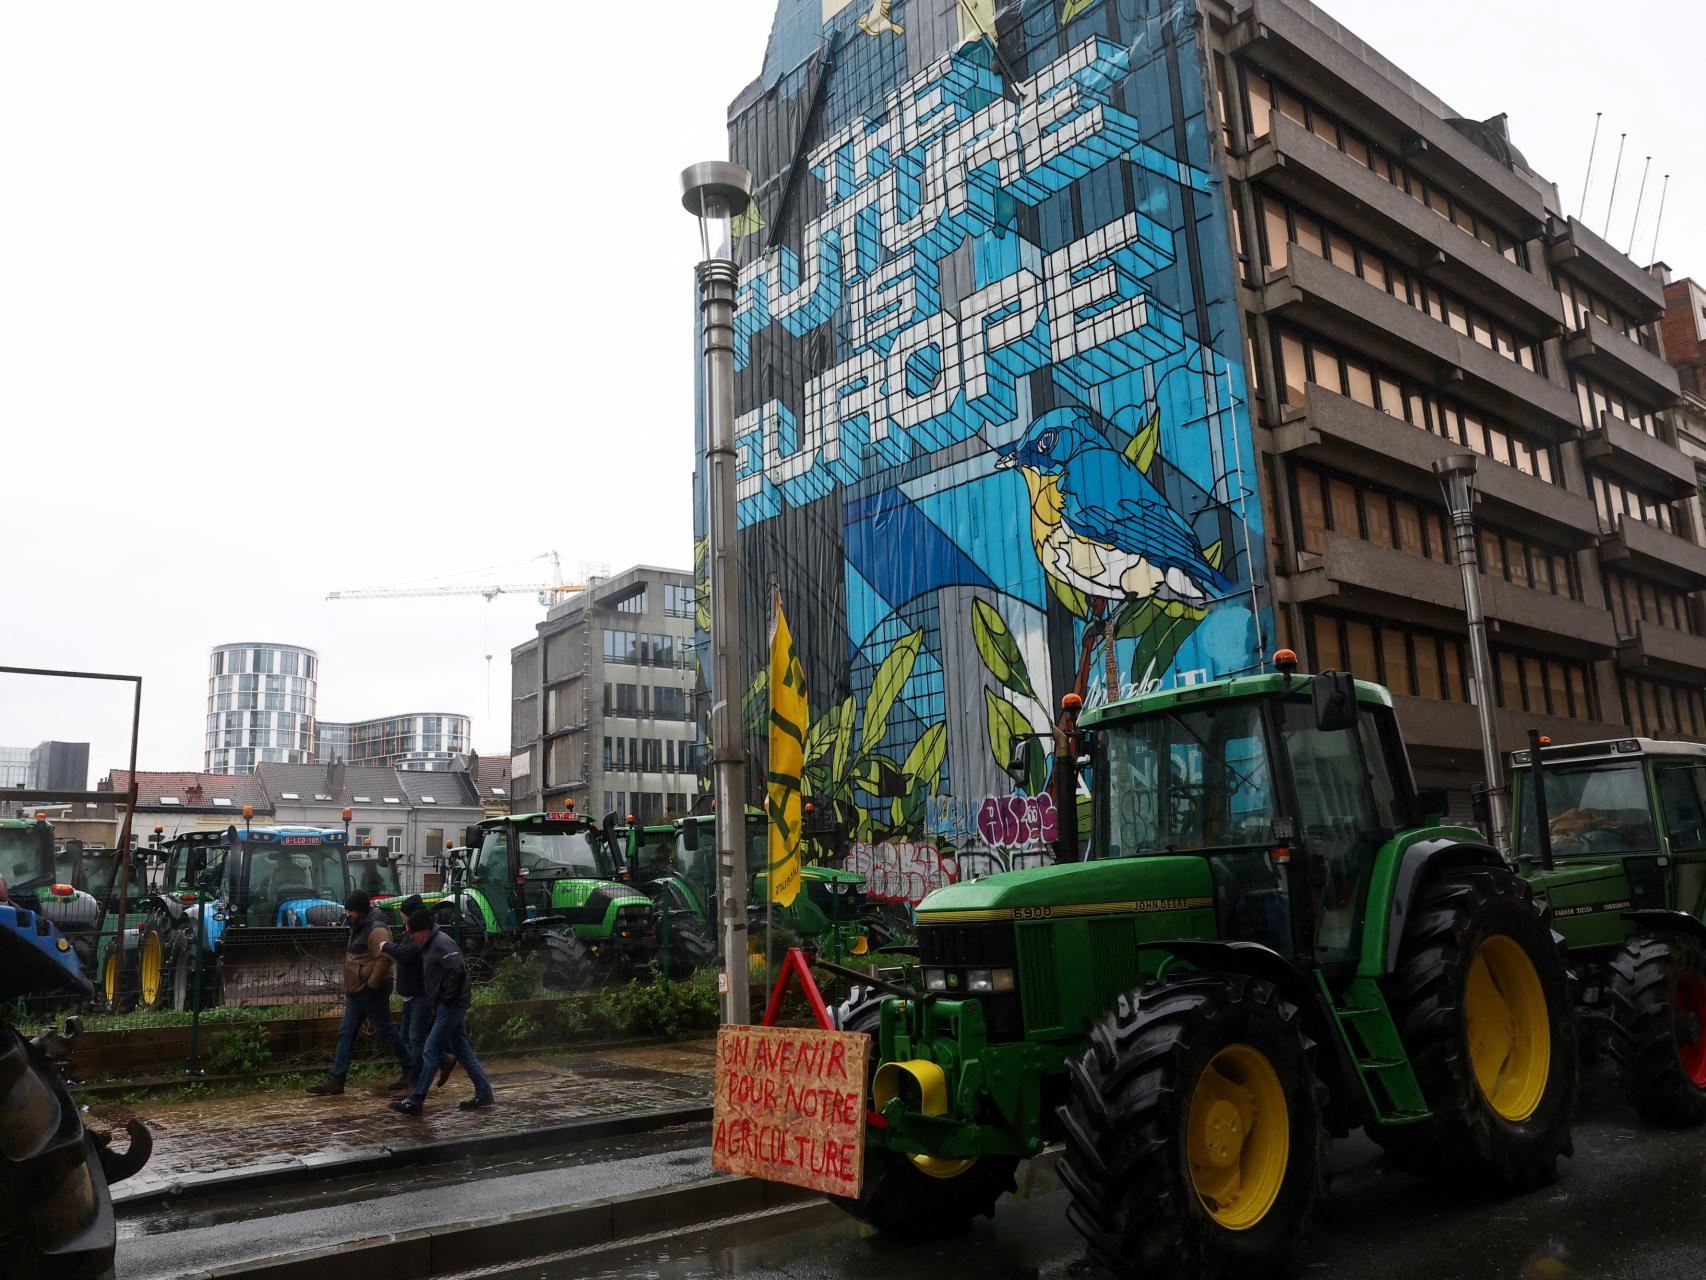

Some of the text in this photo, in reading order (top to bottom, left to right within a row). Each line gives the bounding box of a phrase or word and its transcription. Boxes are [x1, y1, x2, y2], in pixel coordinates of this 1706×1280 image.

[806, 50, 965, 206] THE
[851, 248, 928, 350] IS
[1012, 906, 1052, 920] 6900
[1133, 899, 1189, 912] JOHN DEERE
[722, 1036, 749, 1067] UN
[729, 1071, 858, 1126] POUR NOTRE
